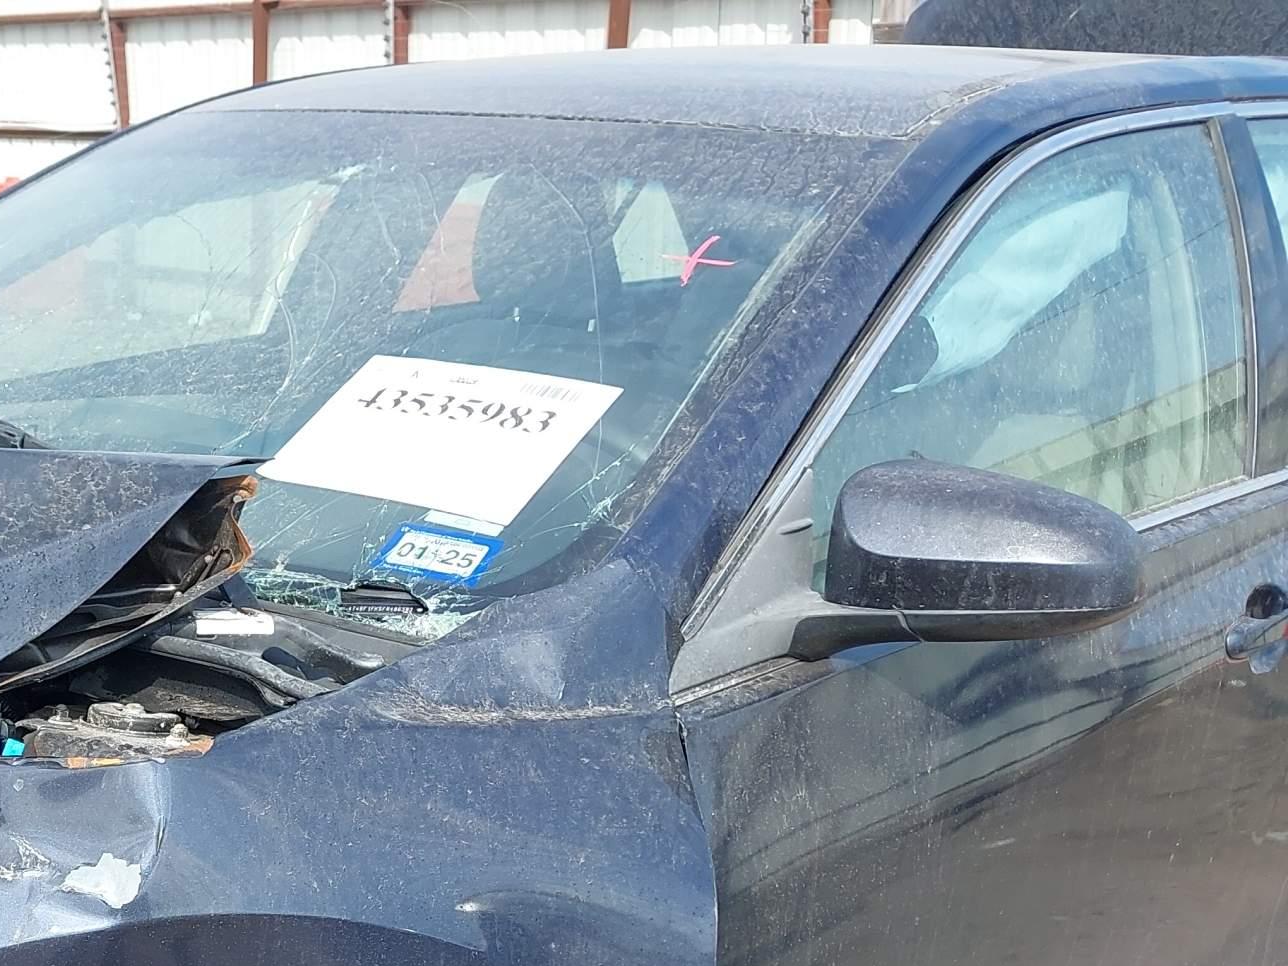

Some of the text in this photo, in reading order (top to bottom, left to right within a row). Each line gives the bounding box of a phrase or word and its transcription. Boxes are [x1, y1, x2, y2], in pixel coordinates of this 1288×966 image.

[357, 387, 557, 433] 43535983
[396, 541, 429, 561] 01
[438, 549, 478, 569] 25
